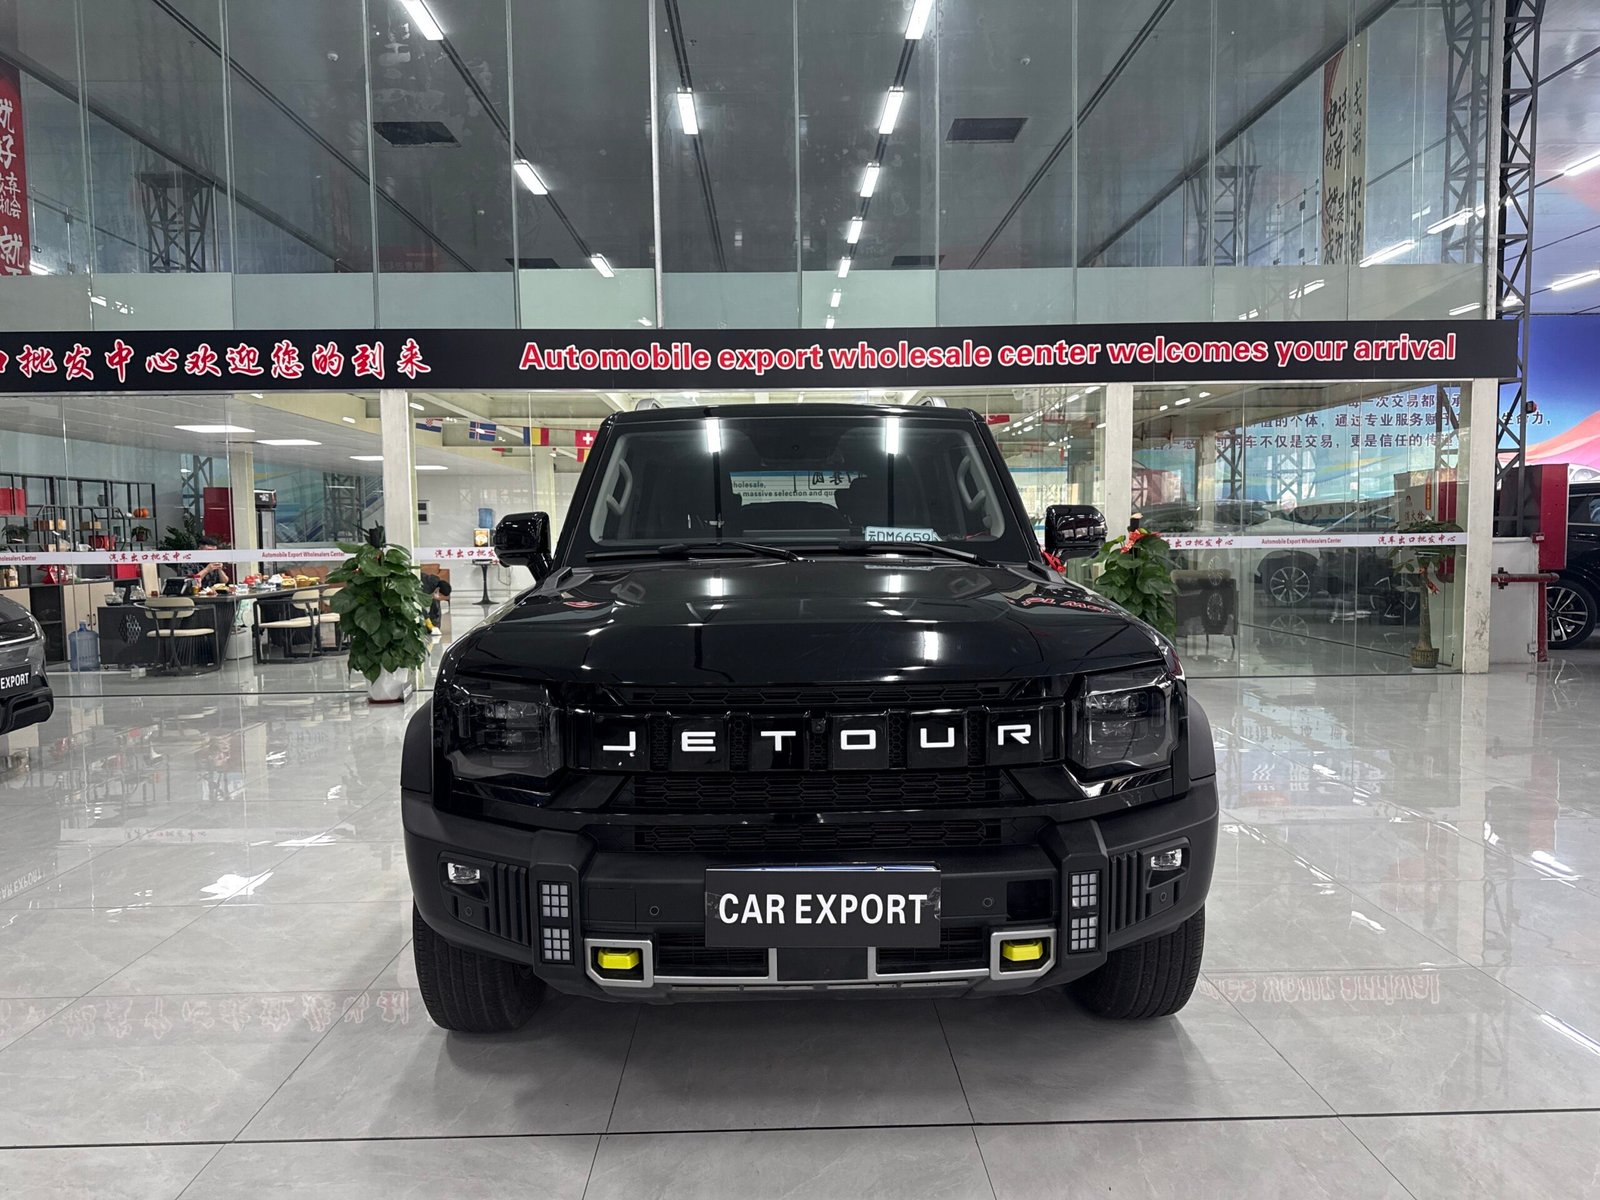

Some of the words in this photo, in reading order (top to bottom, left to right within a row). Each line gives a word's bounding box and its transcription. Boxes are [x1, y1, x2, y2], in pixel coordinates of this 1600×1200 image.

[519, 342, 711, 370] Automobile
[717, 344, 823, 375] export
[829, 340, 992, 369] wholesale
[997, 340, 1101, 367] center
[1107, 336, 1269, 363] welcomes
[1276, 338, 1348, 367] your
[1353, 333, 1456, 361] arrival
[774, 489, 807, 497] selection
[1378, 534, 1456, 545] 汽车出口批发中心
[109, 553, 192, 562] 汽车出口批发中心
[0, 672, 29, 690] EXPORT
[603, 724, 1032, 752] JETOUR
[719, 892, 785, 924] CAR
[795, 893, 928, 924] EXPORT
